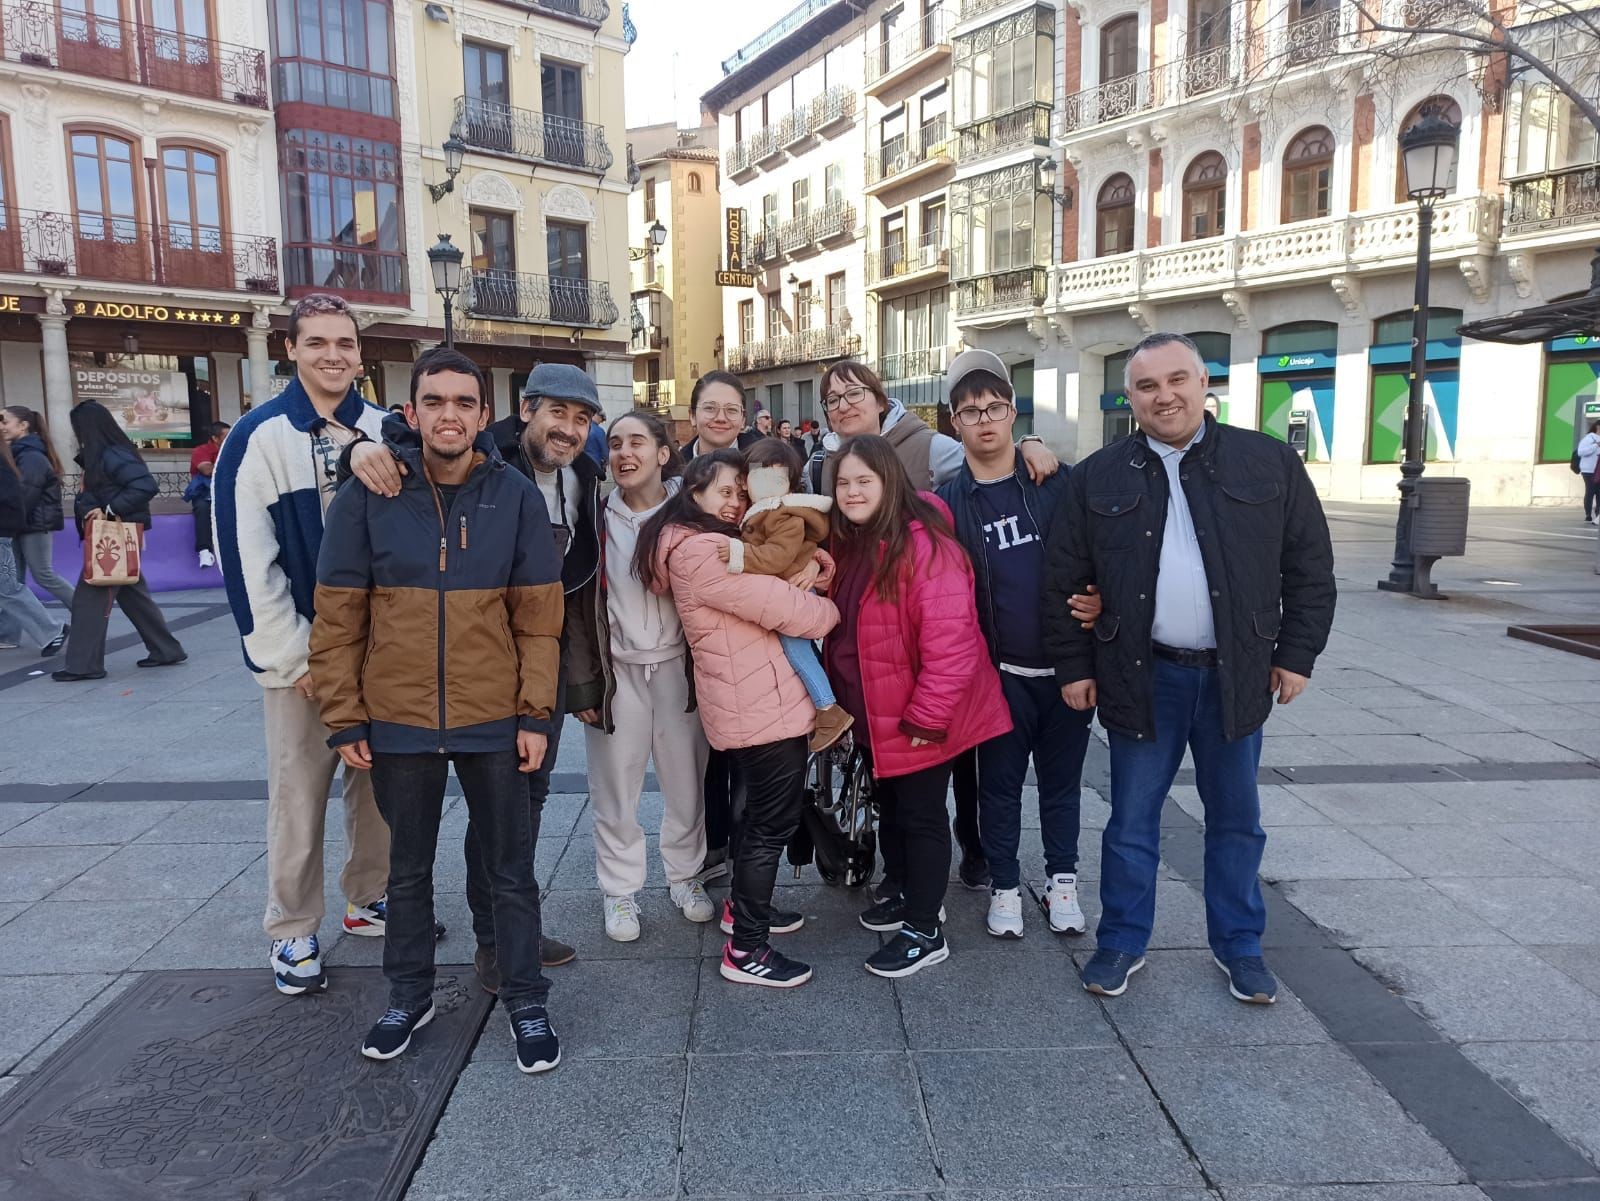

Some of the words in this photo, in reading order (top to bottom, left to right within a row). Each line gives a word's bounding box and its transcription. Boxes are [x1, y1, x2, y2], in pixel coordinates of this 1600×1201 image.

[729, 209, 740, 272] HOSTAL
[718, 272, 753, 286] CENTRO
[94, 303, 169, 321] ADOLFO
[1290, 357, 1314, 366] Unicaja
